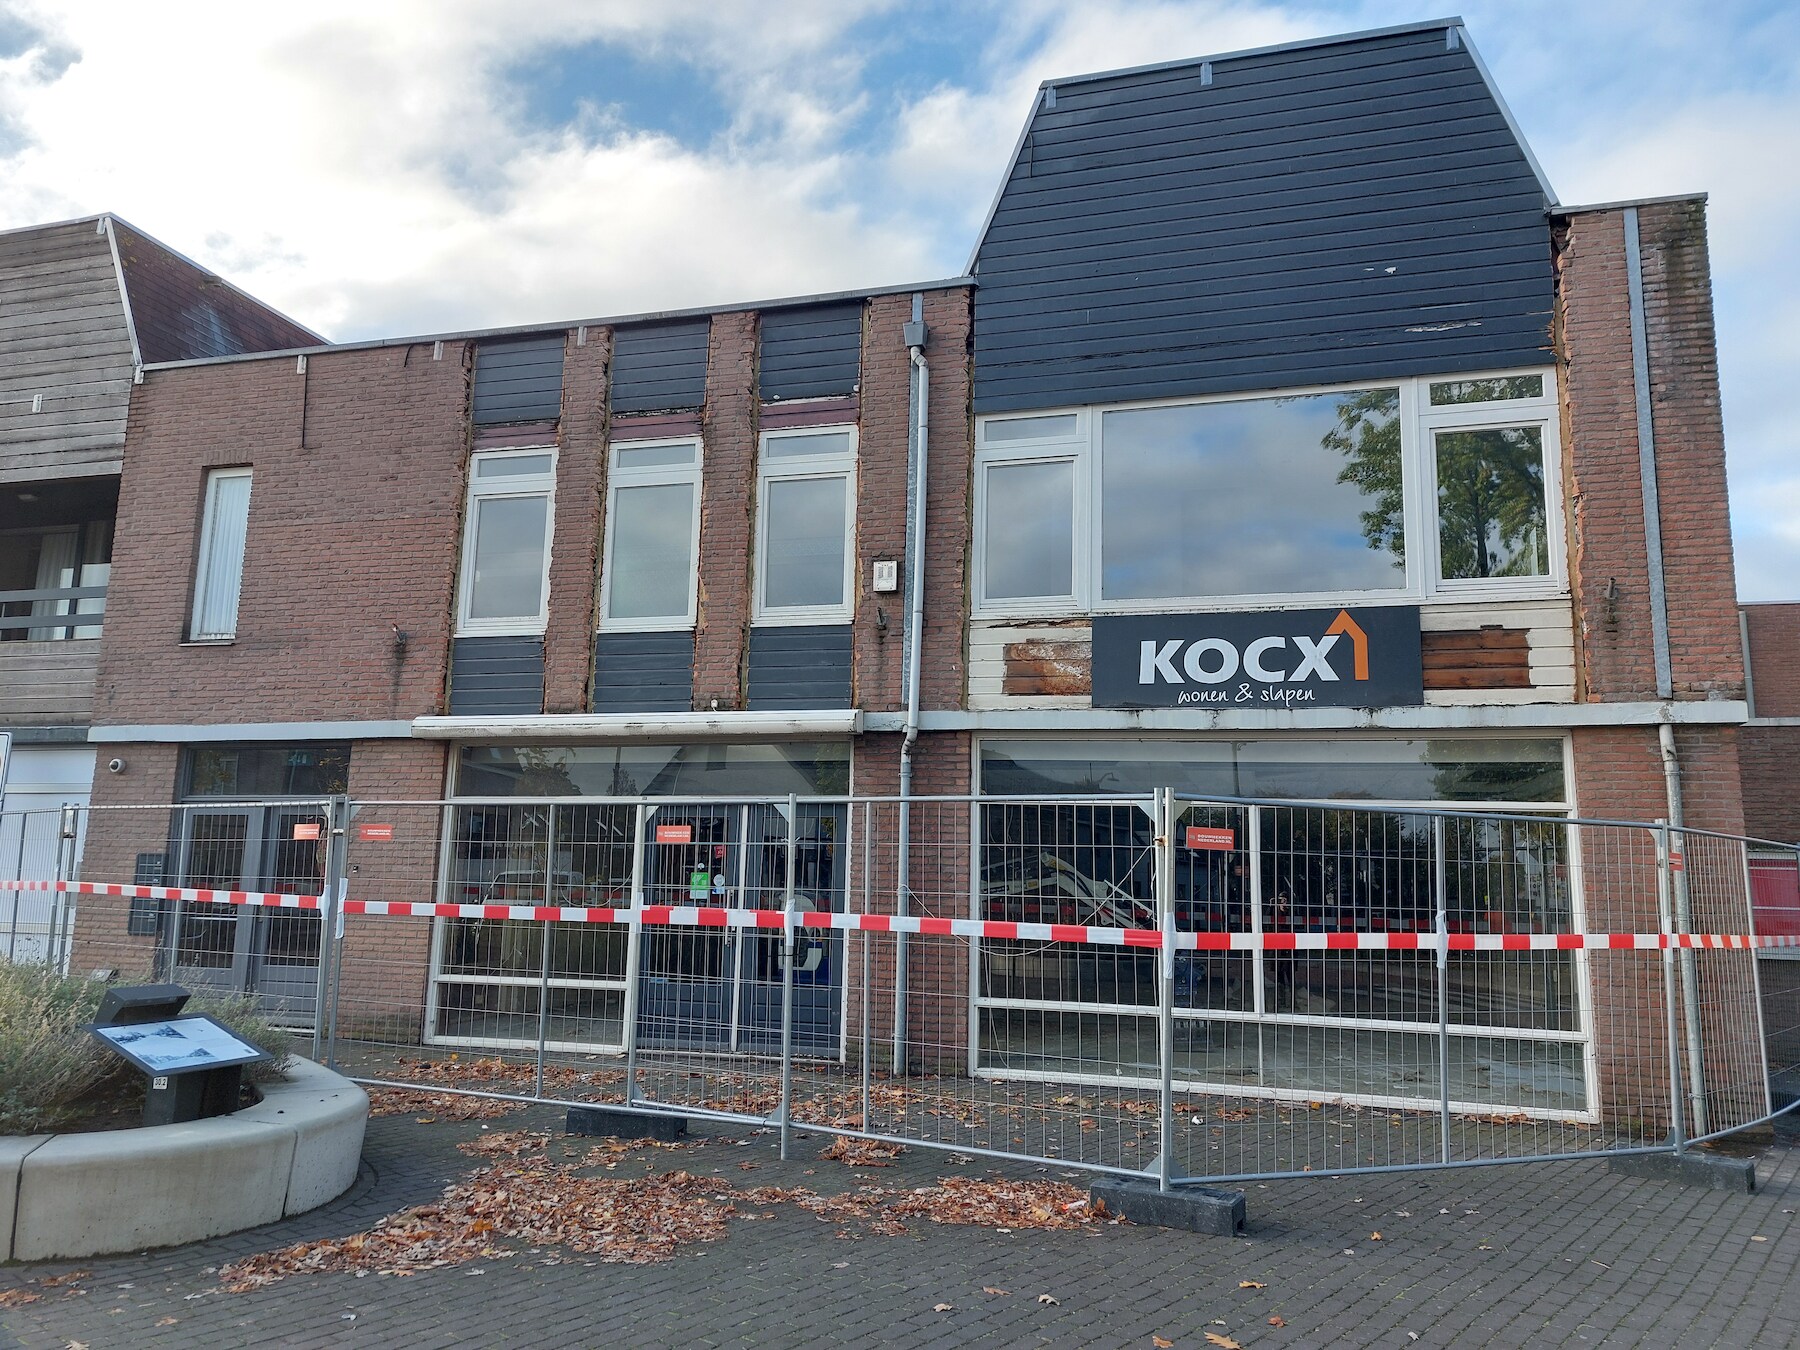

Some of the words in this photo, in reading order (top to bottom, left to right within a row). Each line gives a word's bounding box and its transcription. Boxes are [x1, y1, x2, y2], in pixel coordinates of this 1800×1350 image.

[1139, 635, 1340, 685] KOCX
[1177, 689, 1229, 704] wonen
[1234, 683, 1254, 703] &
[1260, 686, 1316, 707] slapen
